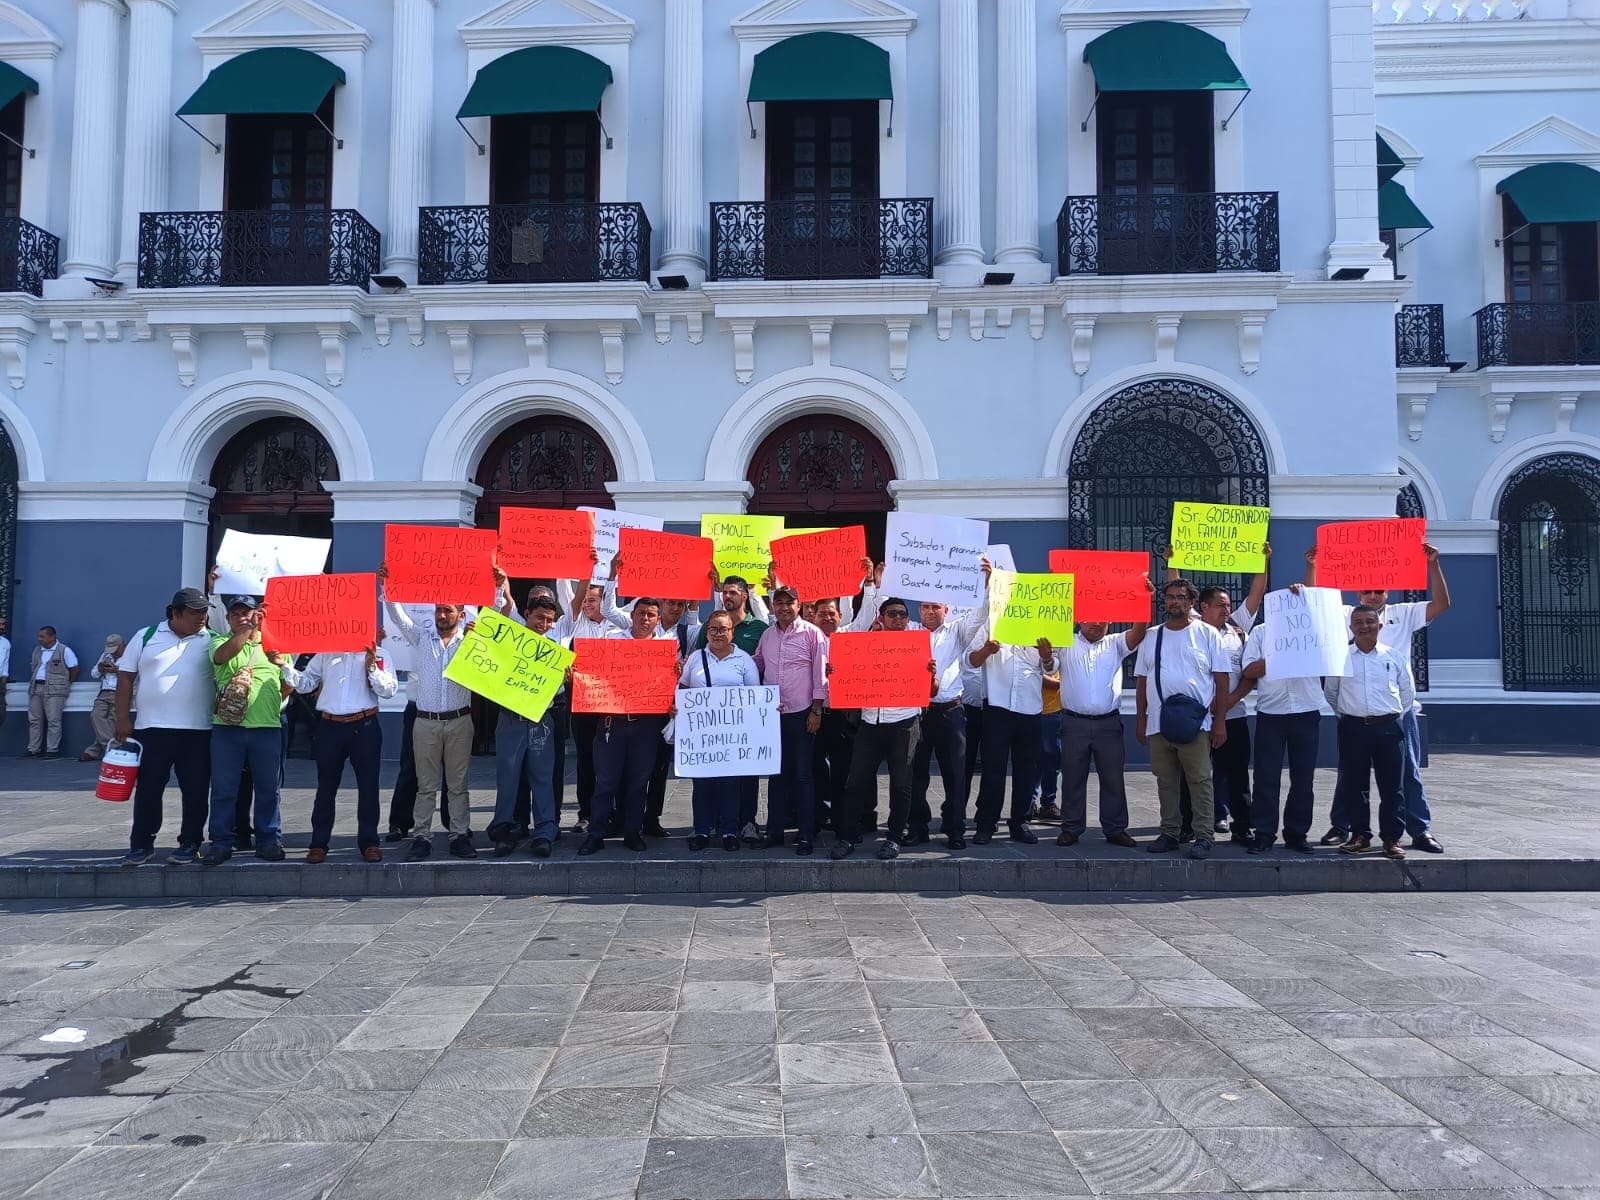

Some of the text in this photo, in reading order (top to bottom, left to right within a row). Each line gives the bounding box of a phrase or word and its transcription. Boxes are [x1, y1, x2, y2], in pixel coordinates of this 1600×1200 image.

[504, 511, 576, 524] QUEREMOS
[1206, 506, 1270, 524] GOBERNADOR
[839, 528, 853, 544] EL
[1177, 523, 1238, 539] MI FAMILIA
[1326, 520, 1425, 545] NECESITAMOS
[389, 531, 405, 545] DE
[413, 532, 433, 548] MI
[624, 535, 697, 551] QUEREMOS
[1175, 540, 1259, 553] DEPENDE DE ESTE
[413, 551, 478, 569] DEPENDE
[620, 551, 681, 562] NUESTROS
[1061, 557, 1080, 571] No
[1184, 552, 1235, 567] EMPLEO
[618, 567, 681, 580] EMPLEOS
[901, 574, 930, 587] Basta
[934, 580, 943, 589] de
[272, 577, 360, 602] QUEREMOS
[1008, 582, 1072, 601] TRASPORTE
[1075, 588, 1138, 601] MPLEOS
[280, 602, 337, 617] SEGUIR
[1038, 604, 1072, 622] PARAR
[272, 619, 368, 637] TRABAJANDO
[1286, 613, 1312, 633] NO
[464, 637, 499, 674] Paga
[851, 663, 867, 672] no
[902, 676, 916, 687] sin
[684, 689, 711, 709] SOY
[720, 687, 756, 708] JEFA
[687, 707, 767, 732] FAMILIA Y
[702, 732, 748, 748] FAMILIA
[680, 745, 772, 766] DEPENDE DE MI
